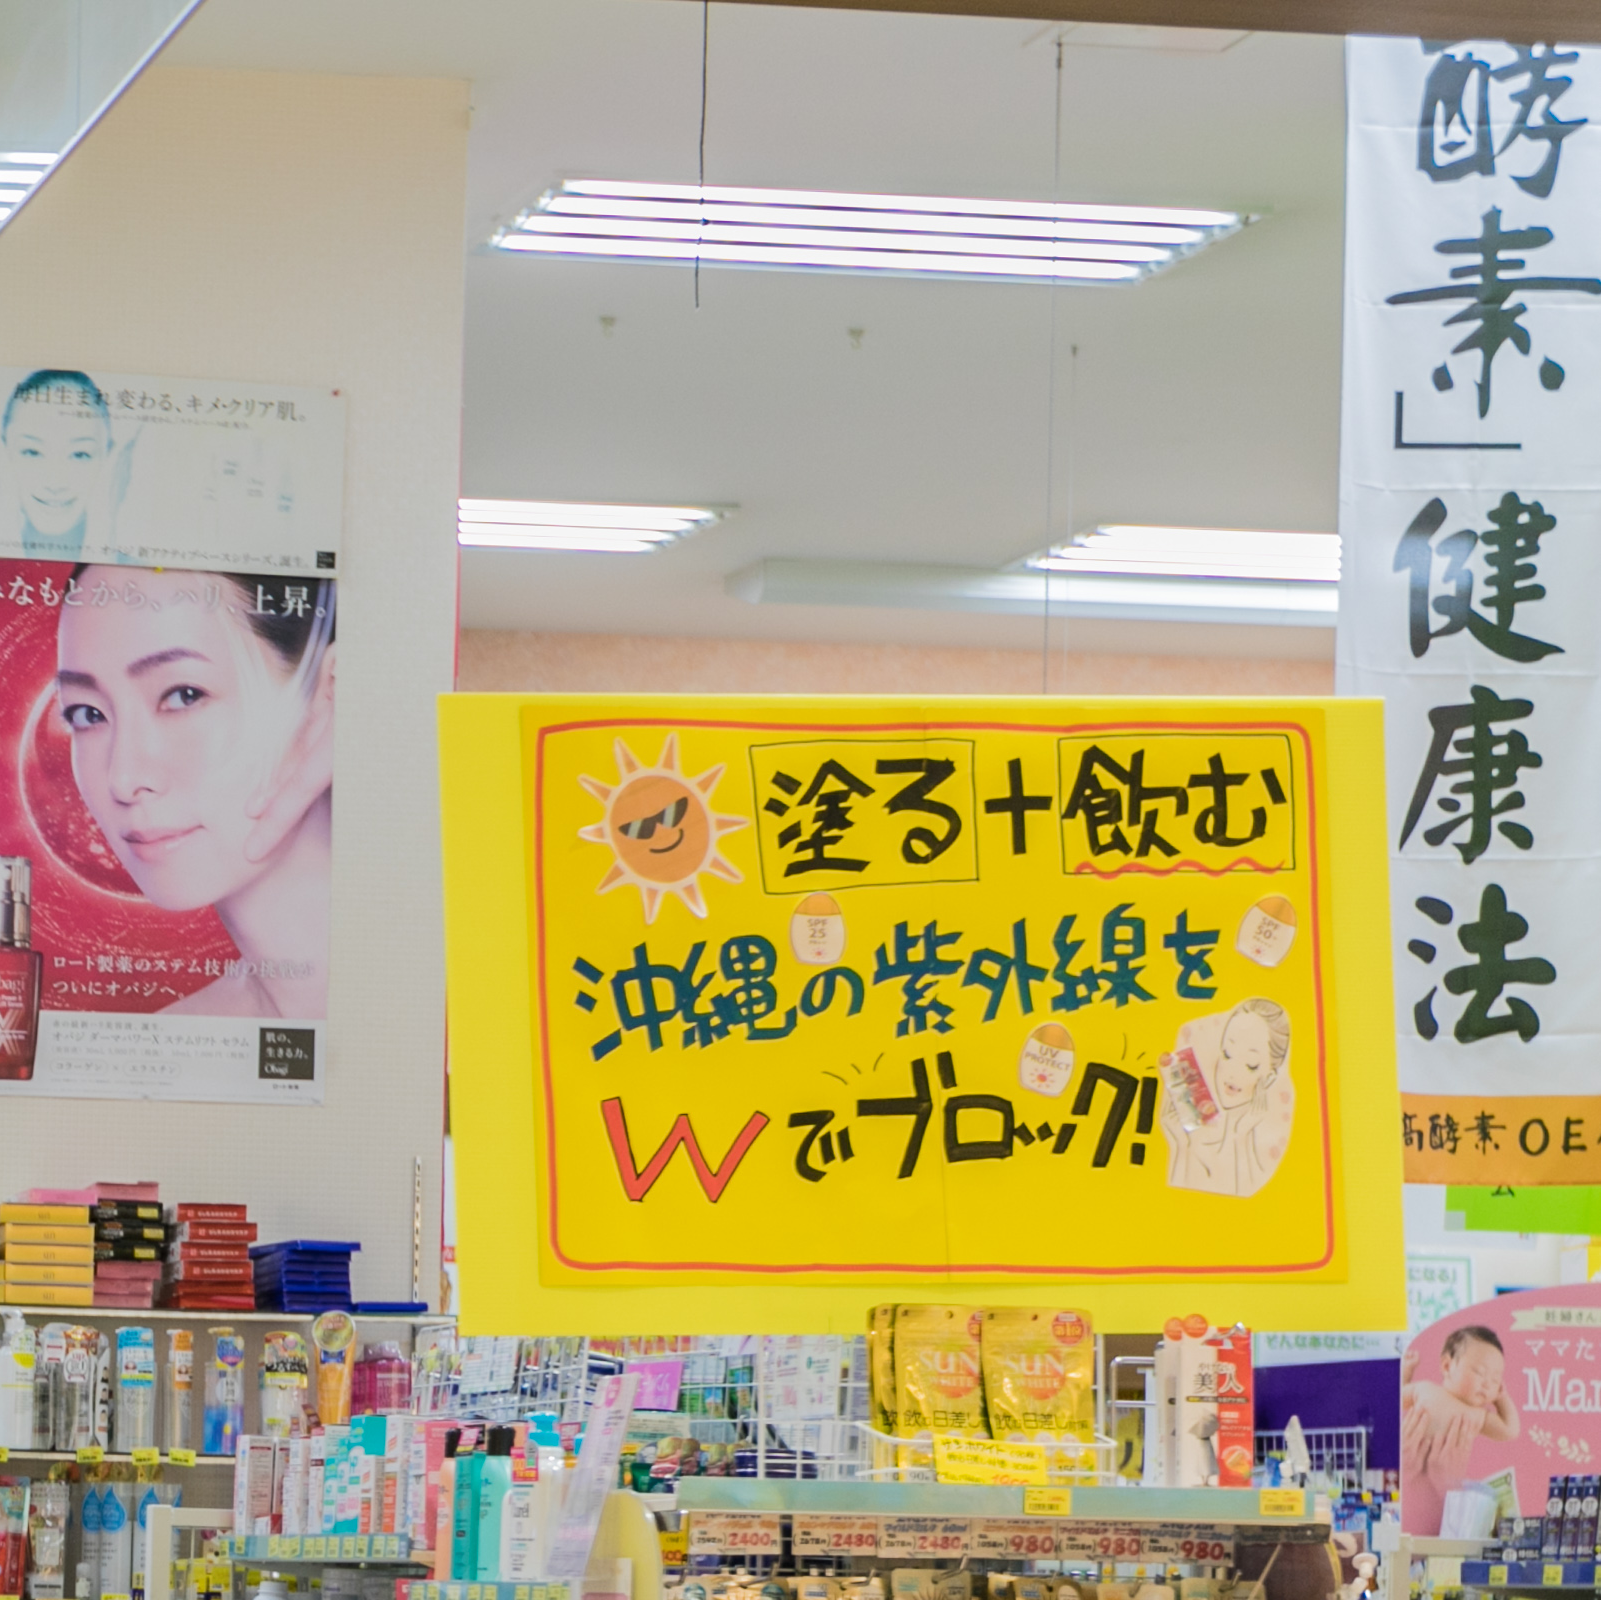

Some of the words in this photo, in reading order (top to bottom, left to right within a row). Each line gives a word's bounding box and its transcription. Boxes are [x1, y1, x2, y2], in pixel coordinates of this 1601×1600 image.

[572, 901, 1222, 1063] 沖縄の紫外線を
[1024, 1051, 1070, 1071] PROTECT
[1037, 1043, 1059, 1060] UV
[1518, 1117, 1601, 1155] OE
[1002, 1350, 1065, 1378] SUN
